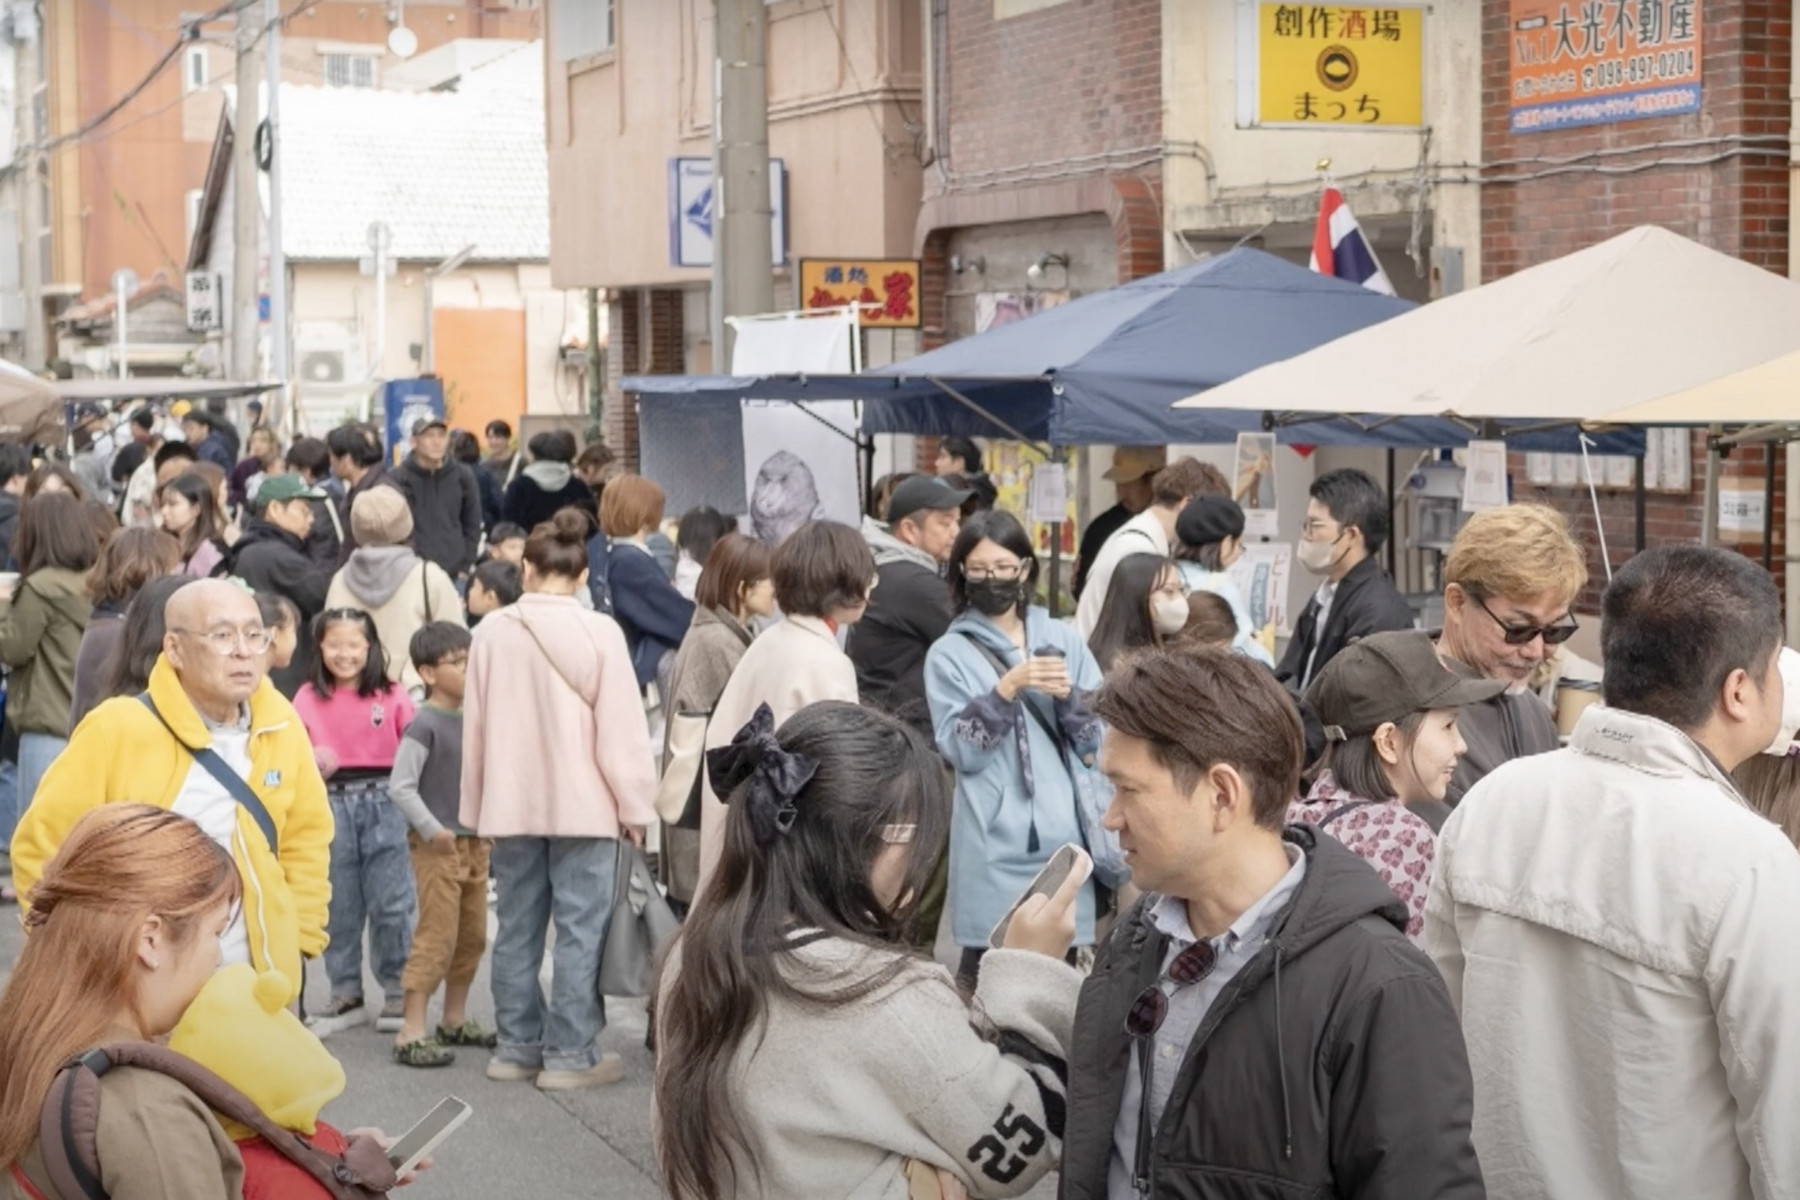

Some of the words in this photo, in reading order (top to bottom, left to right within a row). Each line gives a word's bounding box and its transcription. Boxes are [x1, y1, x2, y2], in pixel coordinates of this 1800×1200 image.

[1274, 5, 1402, 42] 創作酒場
[1551, 0, 1695, 61] 大光不動産
[1597, 49, 1695, 88] 098-897-0204
[1293, 92, 1381, 123] まっち
[966, 1102, 1046, 1185] 25
